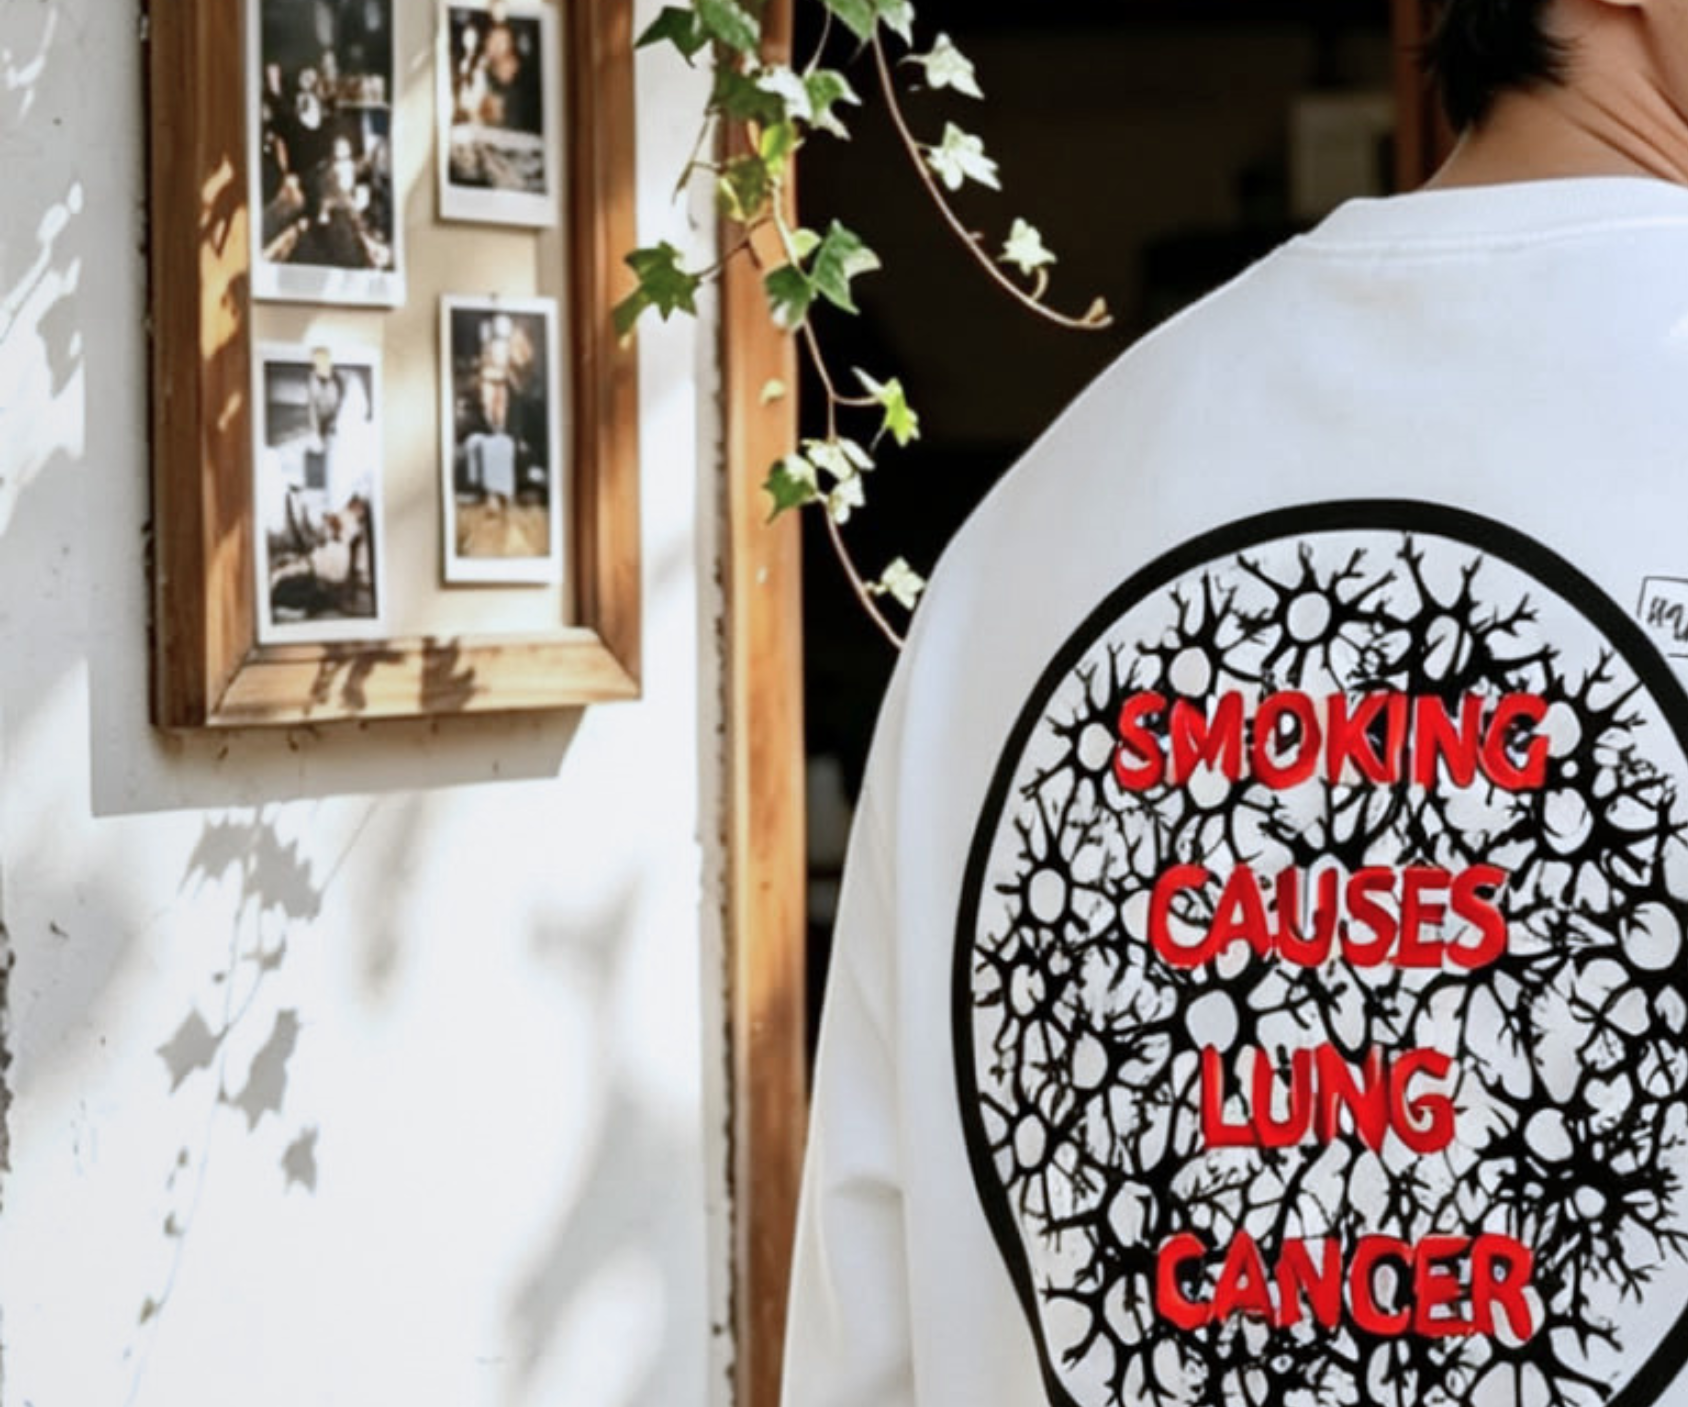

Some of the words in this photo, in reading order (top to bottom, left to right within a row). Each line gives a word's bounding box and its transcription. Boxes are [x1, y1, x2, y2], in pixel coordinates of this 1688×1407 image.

[1114, 691, 1549, 791] SMOKING
[1148, 863, 1508, 969] CAUSES
[1201, 1043, 1455, 1154] LUNG
[1156, 1231, 1533, 1340] CANCER
